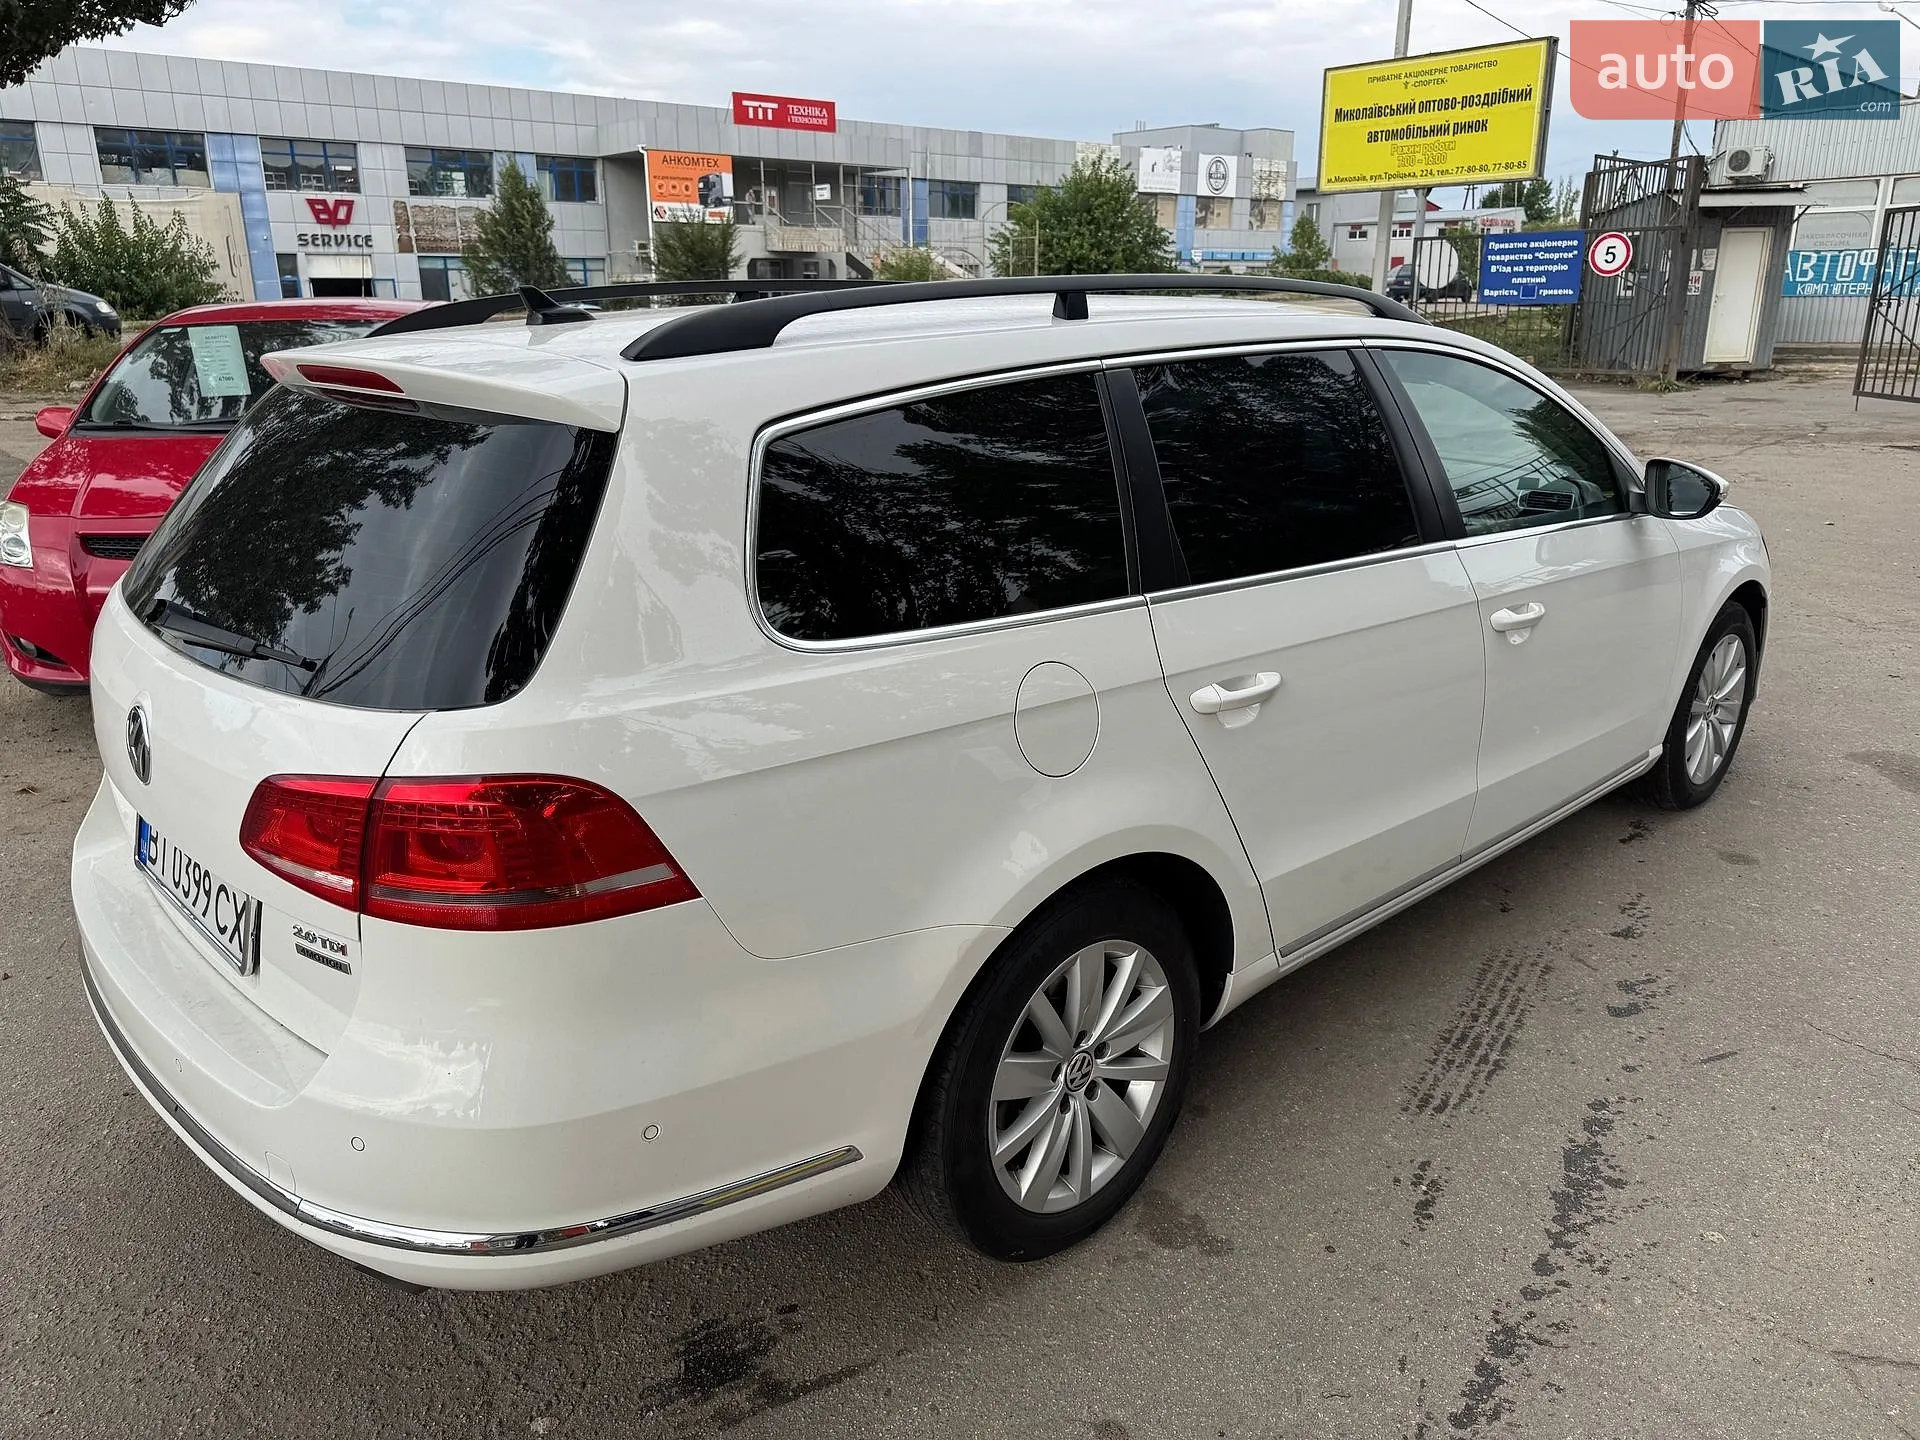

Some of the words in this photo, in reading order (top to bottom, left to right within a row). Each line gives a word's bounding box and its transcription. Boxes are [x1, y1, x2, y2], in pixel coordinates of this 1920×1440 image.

[1367, 72, 1402, 84] ПРИВАТНЕ
[1403, 66, 1448, 79] АКЦІОНЕРНЕ
[1449, 60, 1498, 73] ТОВАРИСТВО
[787, 104, 828, 117] ТЕХНІКА
[1335, 99, 1416, 122] Миколаївський
[1418, 84, 1533, 114] оптово-роздрібний
[1367, 120, 1450, 144] автомобільний
[1453, 119, 1488, 137] ринок
[1391, 143, 1421, 156] Режим
[1422, 140, 1456, 156] роботи
[662, 155, 720, 168] АНКОМТЕХ
[297, 233, 373, 248] SERVICE
[1488, 241, 1528, 251] Приватне
[1529, 239, 1579, 249] акціонерне
[1487, 253, 1533, 263] товариство
[1604, 246, 1616, 264] 5
[1525, 263, 1569, 273] територію
[1511, 275, 1547, 284] платний
[1483, 288, 1518, 297] Вартість
[1539, 288, 1573, 297] гривень
[173, 846, 212, 918] 0399
[216, 883, 247, 953] CX
[318, 935, 349, 957] TDI
